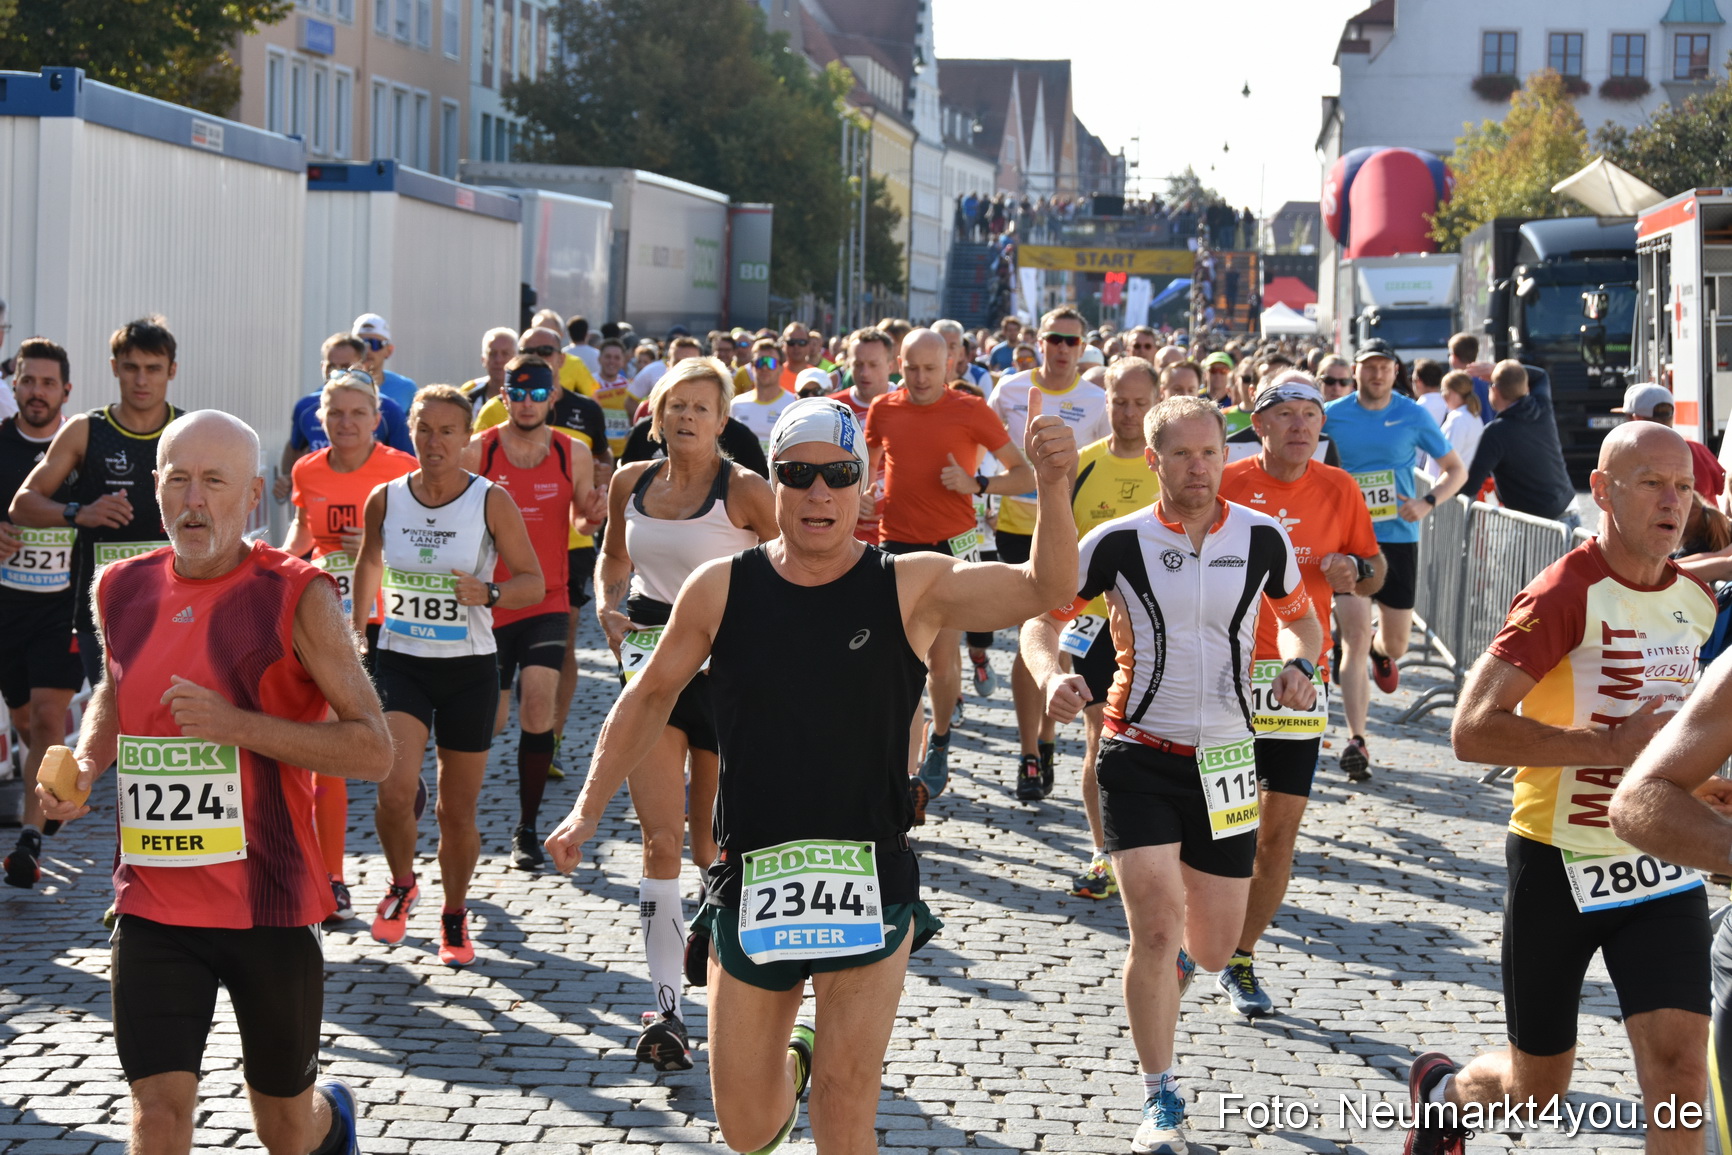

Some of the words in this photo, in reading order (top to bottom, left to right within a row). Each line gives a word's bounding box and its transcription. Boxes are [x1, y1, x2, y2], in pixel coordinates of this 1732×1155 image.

[1076, 252, 1136, 268] START
[409, 529, 457, 538] INTERSPORT
[410, 536, 448, 545] LANGE
[8, 549, 66, 569] 2521
[7, 572, 68, 584] SEBASTIAN
[391, 593, 459, 621] 2183
[1142, 592, 1160, 630] Radfreunde
[410, 625, 437, 638] EVA
[1647, 645, 1690, 657] FITNESS
[1252, 718, 1319, 726] ANS-WERNER
[123, 742, 224, 771] BOCK
[128, 783, 224, 821] 1224
[142, 835, 204, 851] PETER
[752, 845, 865, 881] BOCK
[1583, 854, 1682, 898] 2805
[755, 881, 864, 921] 2344
[775, 929, 845, 945] PETER
